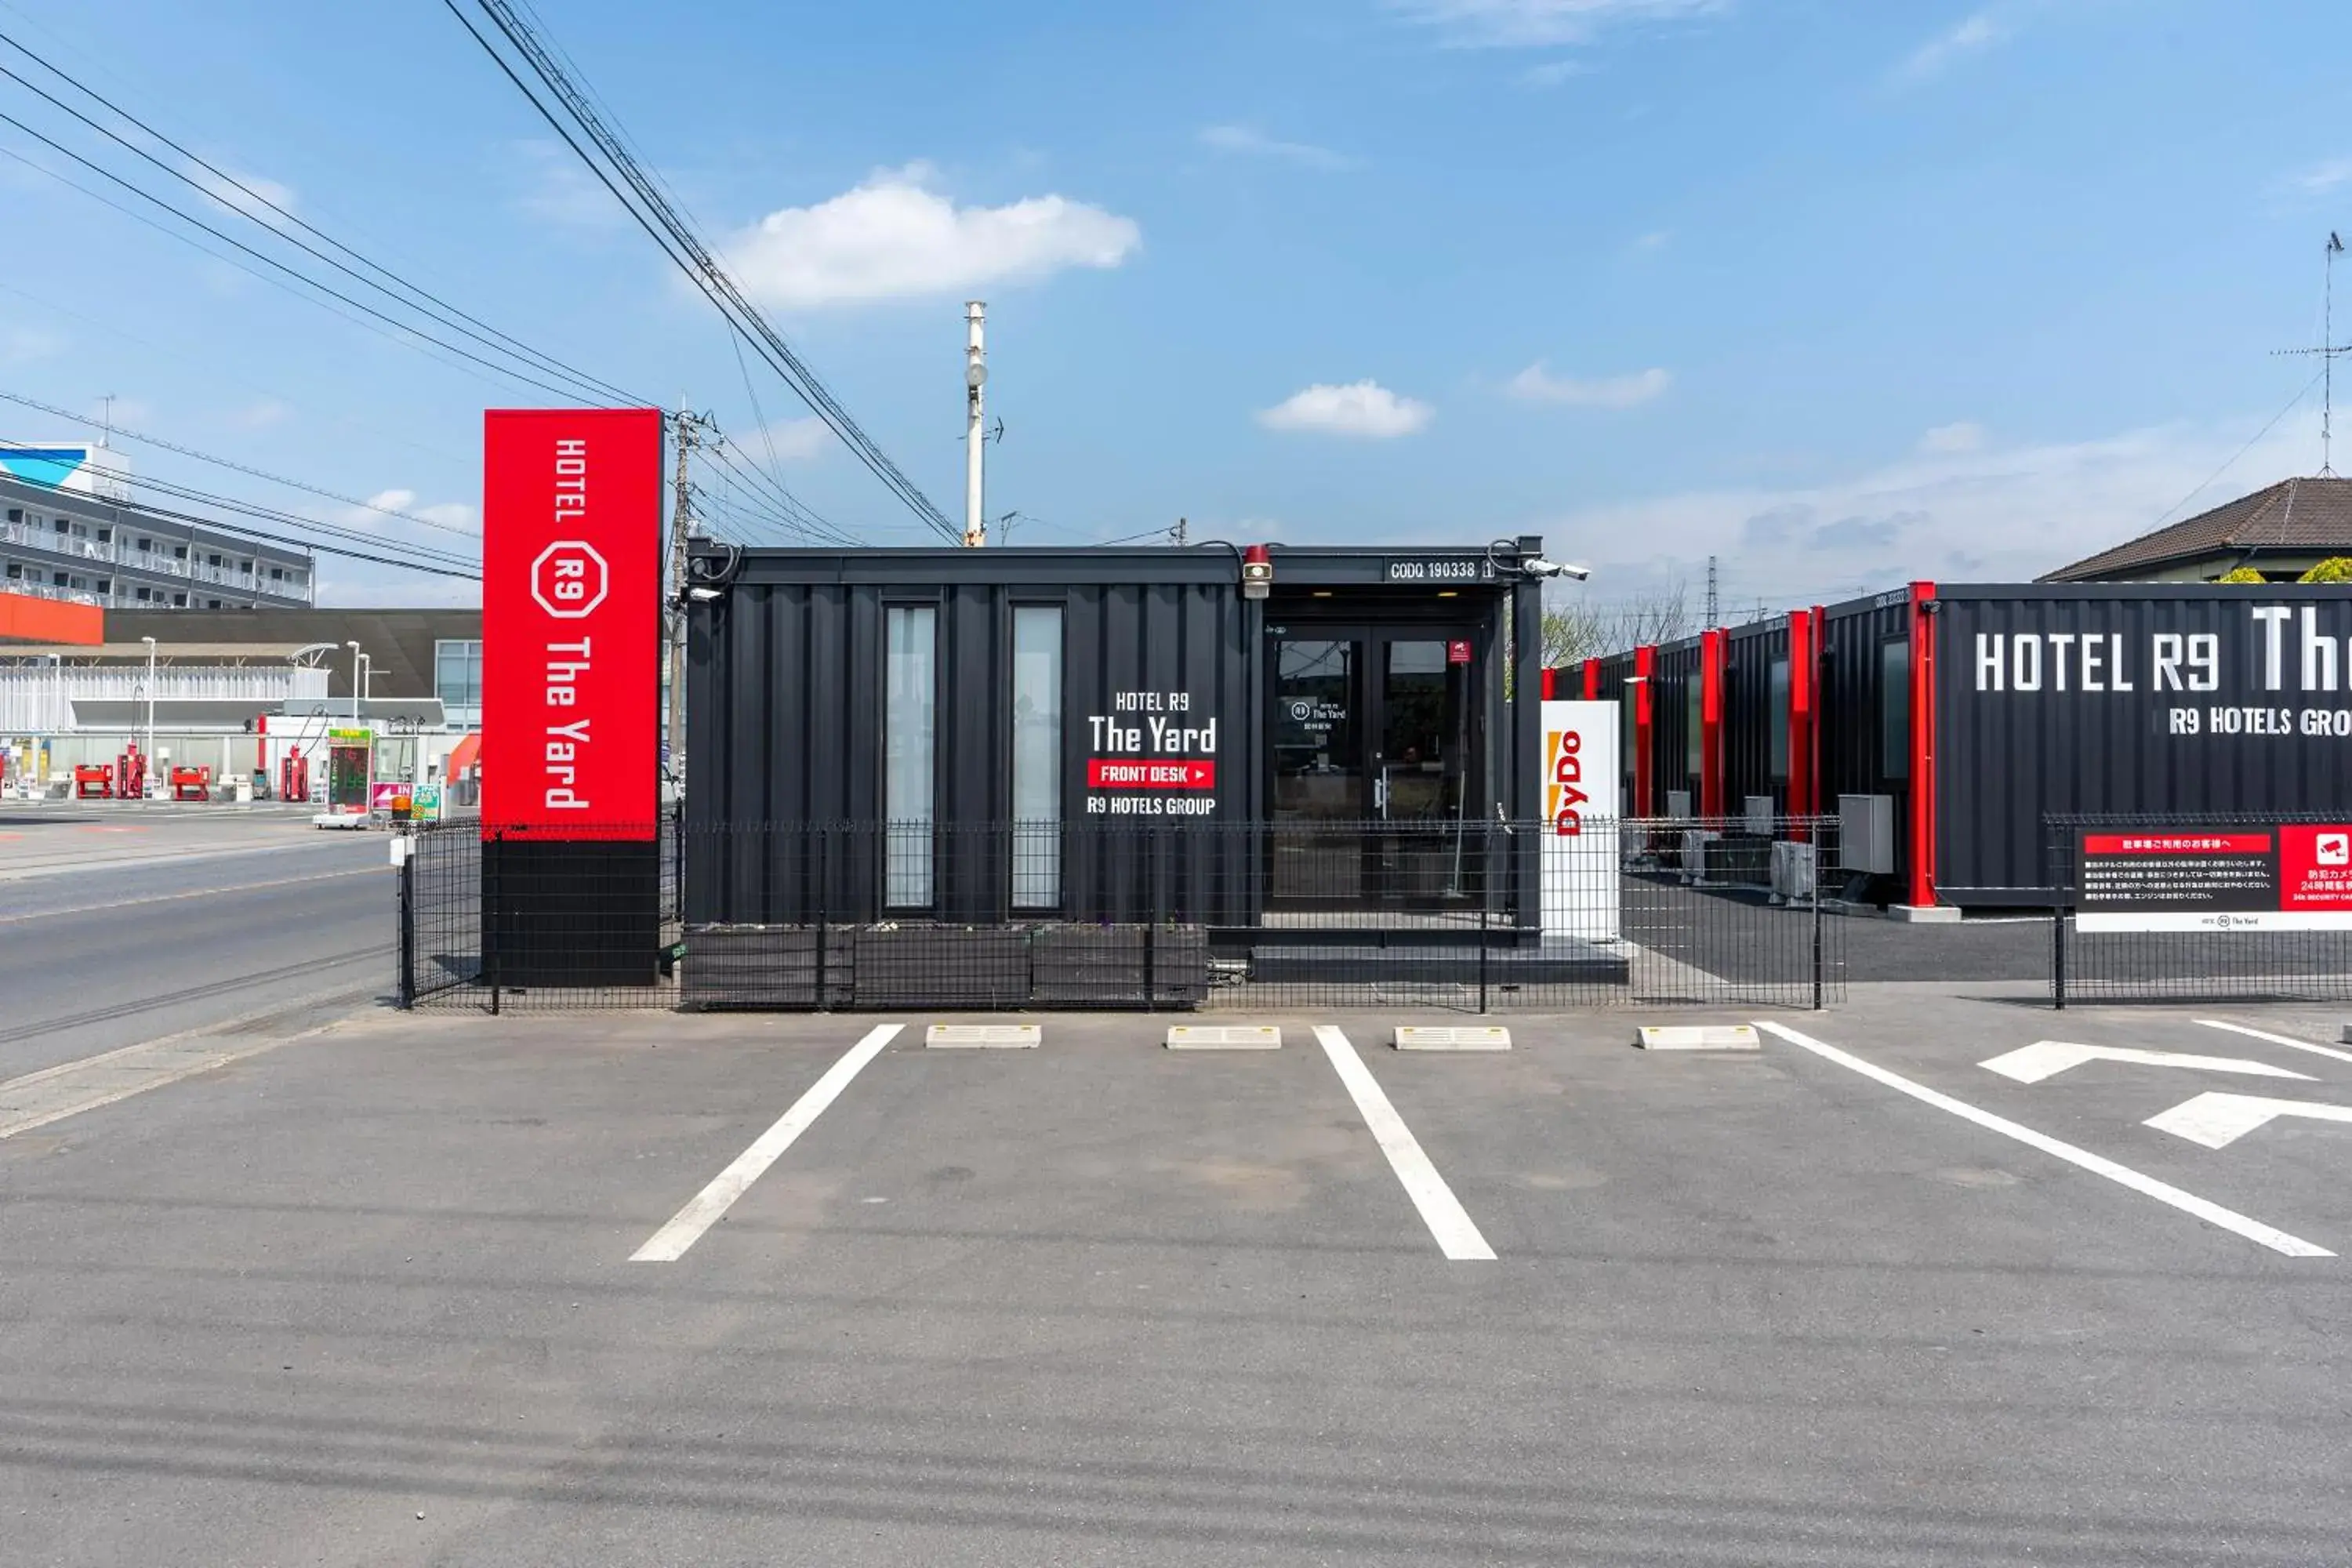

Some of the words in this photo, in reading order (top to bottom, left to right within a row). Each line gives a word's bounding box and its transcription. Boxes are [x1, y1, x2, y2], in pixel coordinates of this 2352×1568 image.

[556, 440, 586, 523] HOTEL
[554, 559, 584, 600] R9
[1392, 563, 1424, 578] CODQ
[1428, 562, 1475, 578] 190338
[1976, 633, 2132, 691] HOTEL
[2153, 633, 2219, 691] R9
[2252, 606, 2352, 691] Th
[546, 636, 591, 706] The
[1116, 692, 1163, 711] HOTEL
[1169, 692, 1189, 711] R9
[2169, 707, 2199, 735] R9
[2210, 706, 2292, 735] HOTELS
[2299, 708, 2352, 735] GRO
[1088, 716, 1142, 753] The
[1149, 717, 1216, 753] Yard
[545, 718, 590, 808] Yard
[1101, 765, 1147, 782] FRONT
[1150, 766, 1189, 782] DESK
[1556, 730, 1588, 836] DyDo
[1087, 796, 1106, 814] R9
[1111, 797, 1162, 815] HOTELS
[1166, 797, 1215, 815] GROUP
